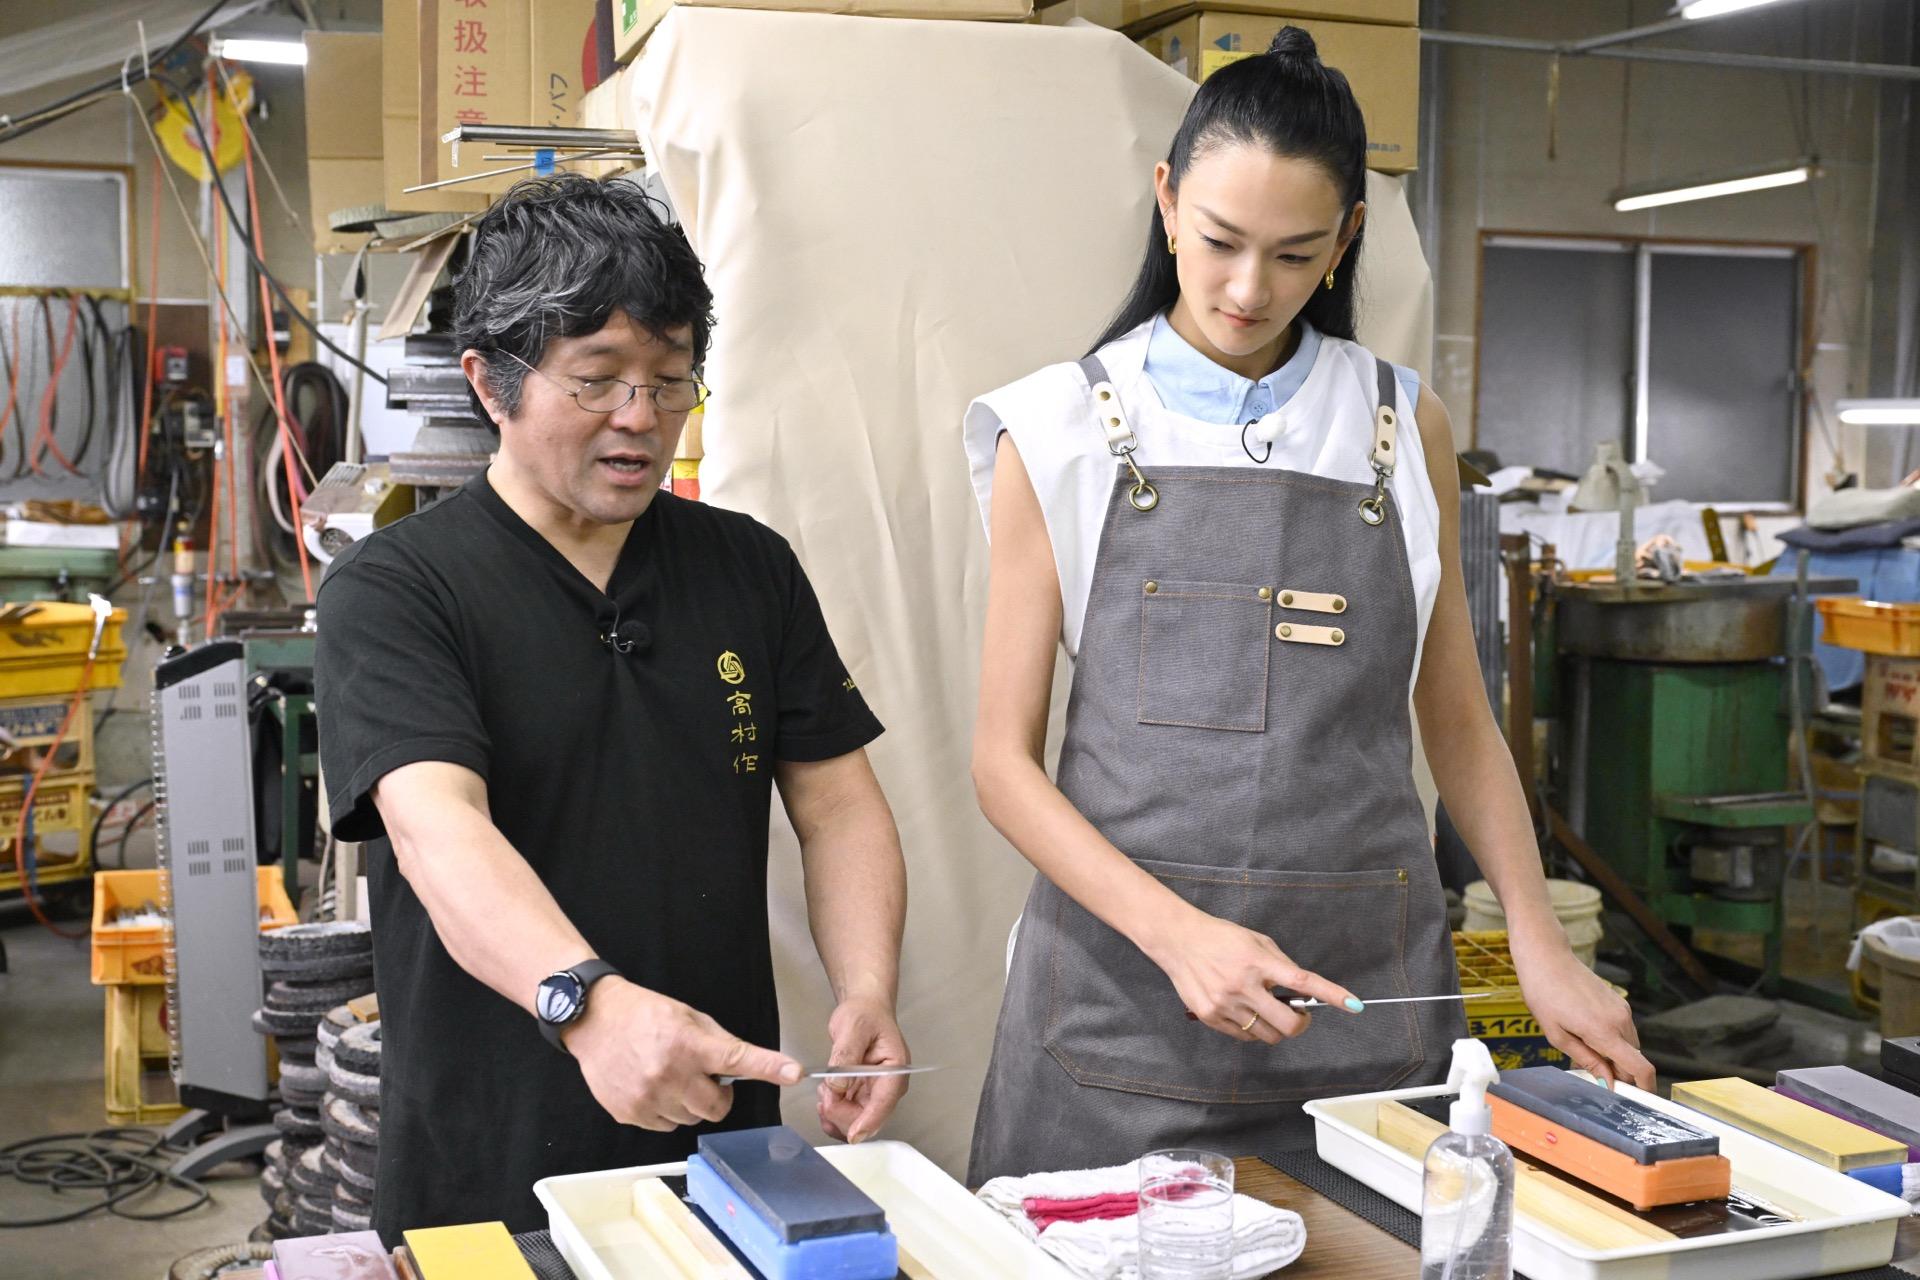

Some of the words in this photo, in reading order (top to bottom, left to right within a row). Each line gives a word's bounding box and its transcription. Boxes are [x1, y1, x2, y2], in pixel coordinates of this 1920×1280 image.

[454, 0, 487, 125] 扱注
[727, 691, 759, 774] 高村作
